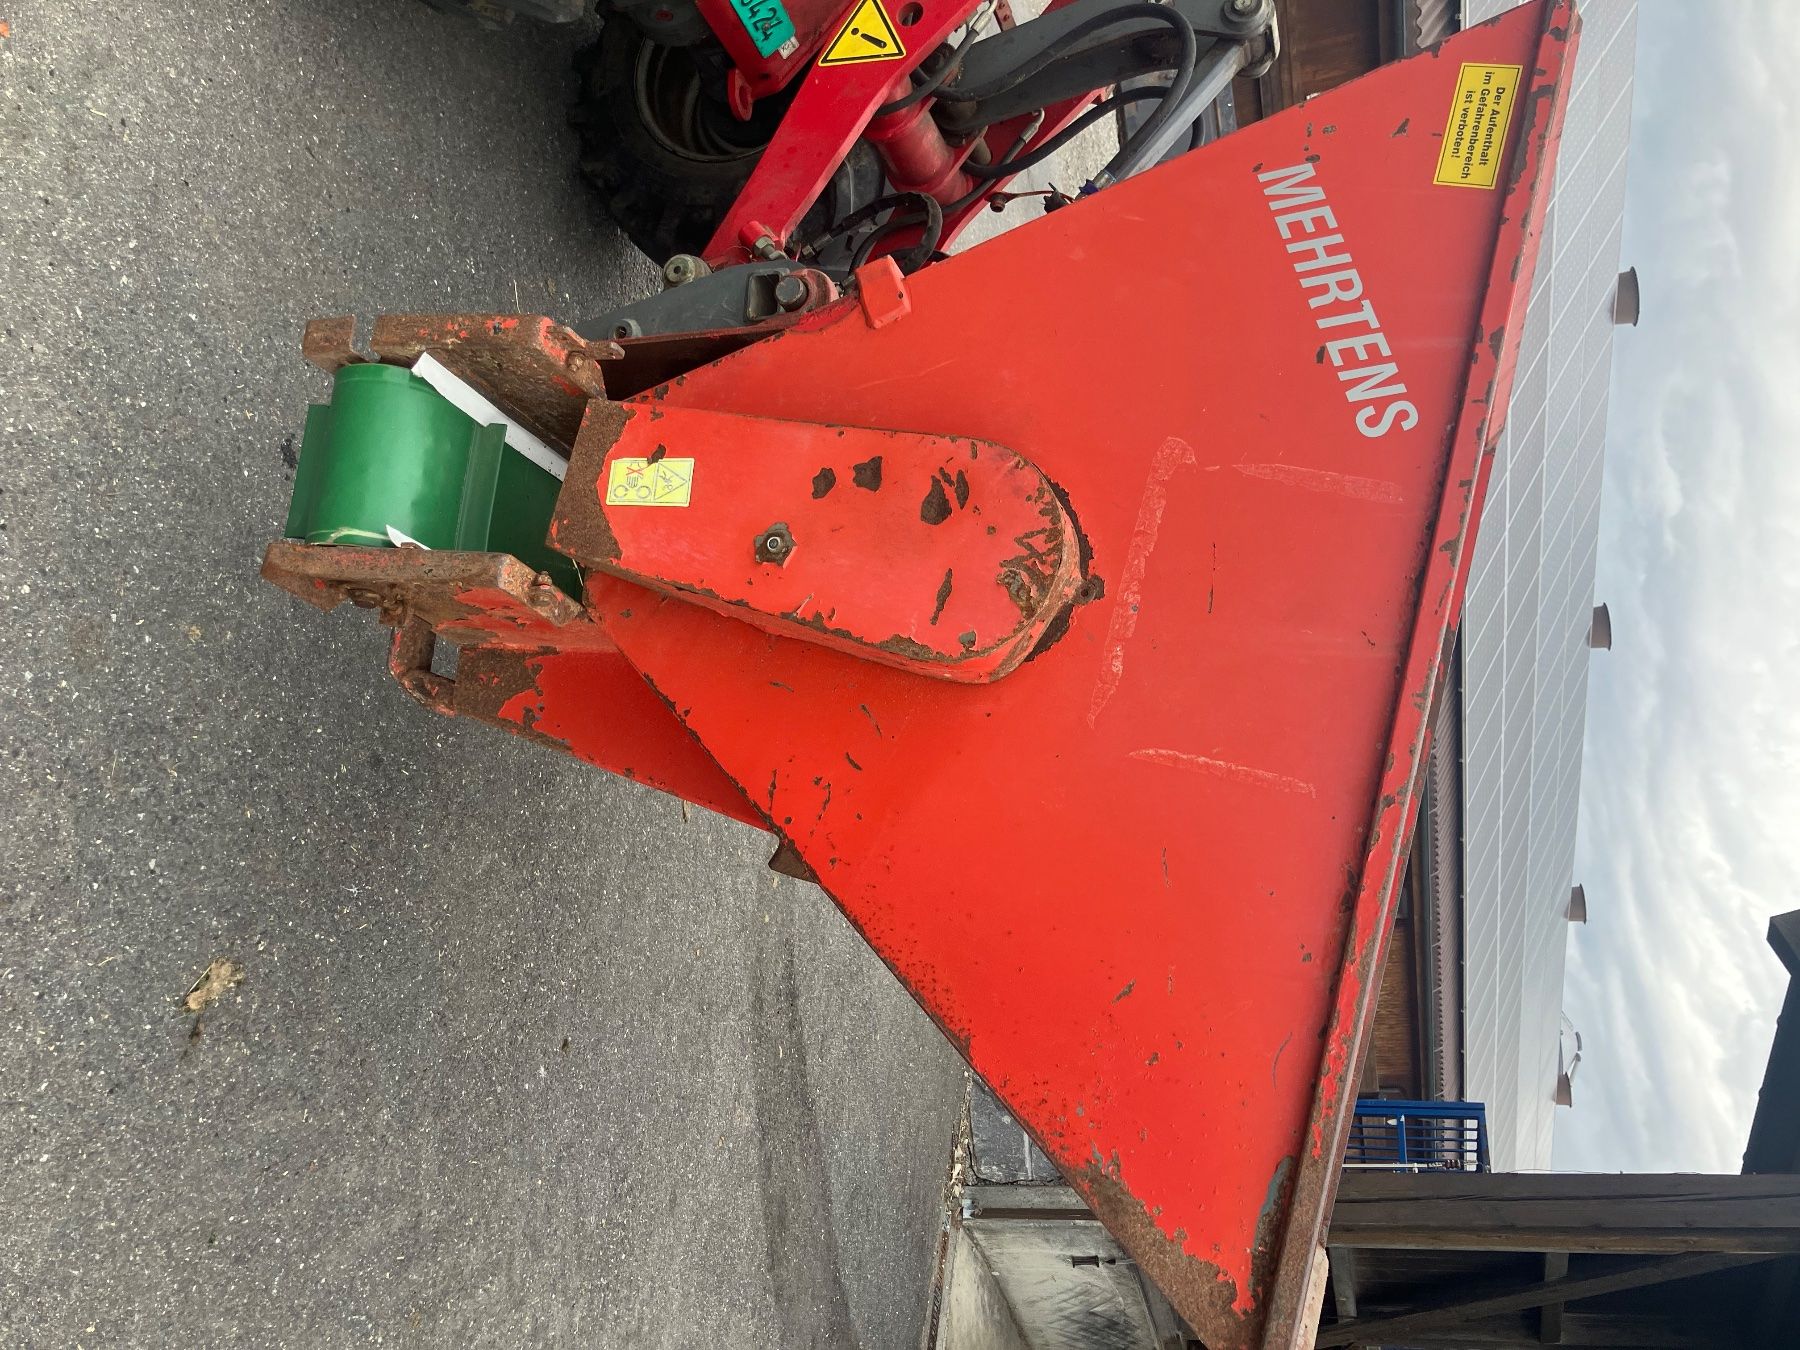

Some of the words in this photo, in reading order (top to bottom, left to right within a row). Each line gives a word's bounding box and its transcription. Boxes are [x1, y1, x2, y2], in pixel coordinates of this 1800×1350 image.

[1464, 90, 1476, 104] ist
[1482, 71, 1495, 85] im
[1493, 87, 1506, 106] Der
[1451, 107, 1470, 158] verboten!
[1460, 88, 1491, 179] Gefahrenbereich
[1478, 109, 1500, 166] Aufenthalt
[1257, 162, 1419, 438] MEHRTENS
